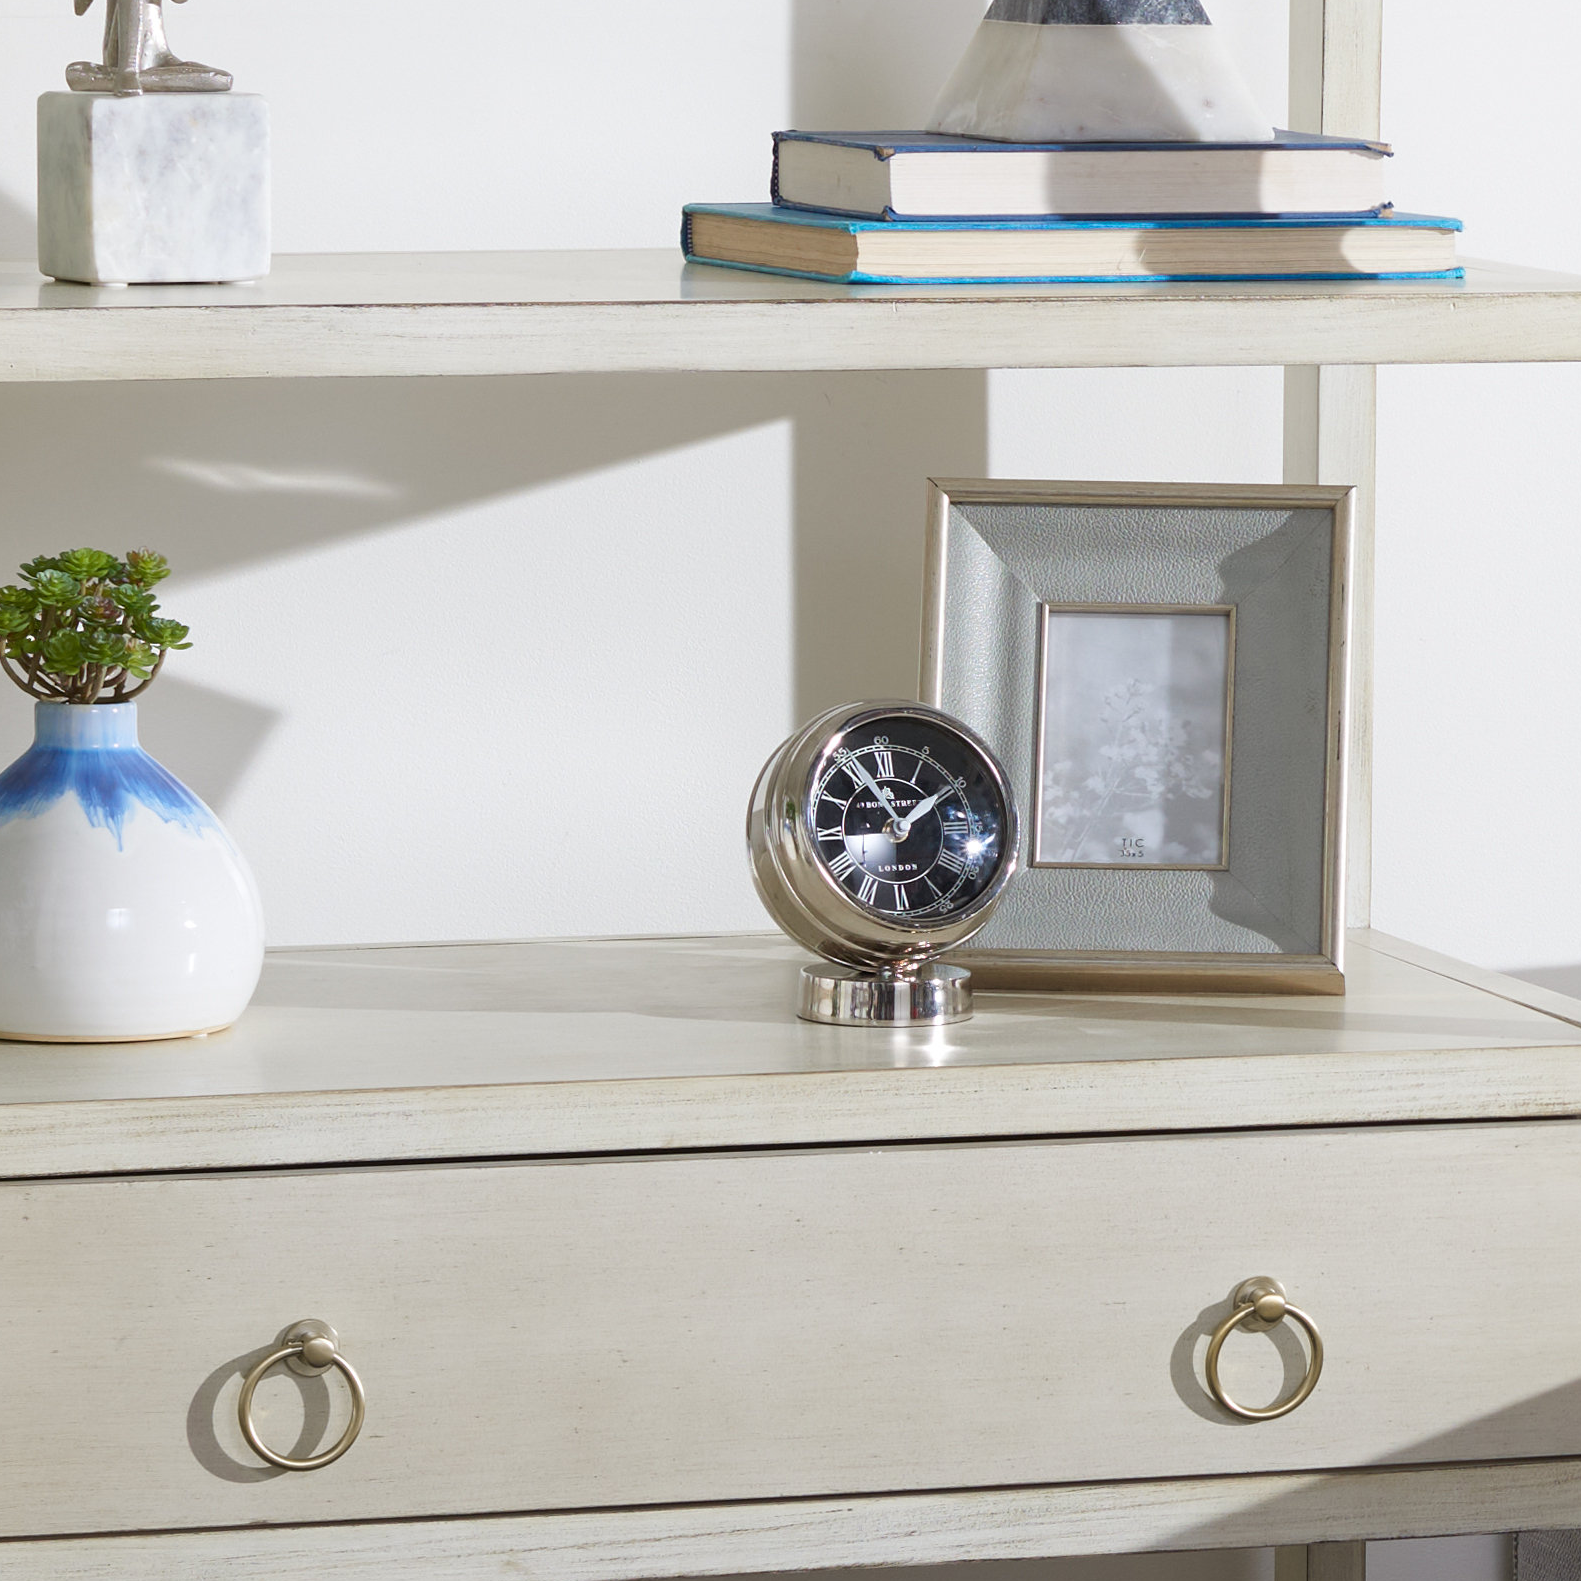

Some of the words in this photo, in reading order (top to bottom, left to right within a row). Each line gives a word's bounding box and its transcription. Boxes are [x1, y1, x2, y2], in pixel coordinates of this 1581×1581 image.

[873, 735, 890, 745] 60
[832, 747, 847, 762] 55
[921, 745, 931, 755] 5
[874, 751, 895, 778] XII
[820, 789, 847, 810] X
[816, 825, 844, 841] IX
[942, 821, 969, 835] III
[828, 850, 857, 882] VIII
[878, 863, 918, 872] LONDON
[858, 874, 879, 905] VII
[923, 875, 943, 900] V
[893, 884, 910, 910] VI
